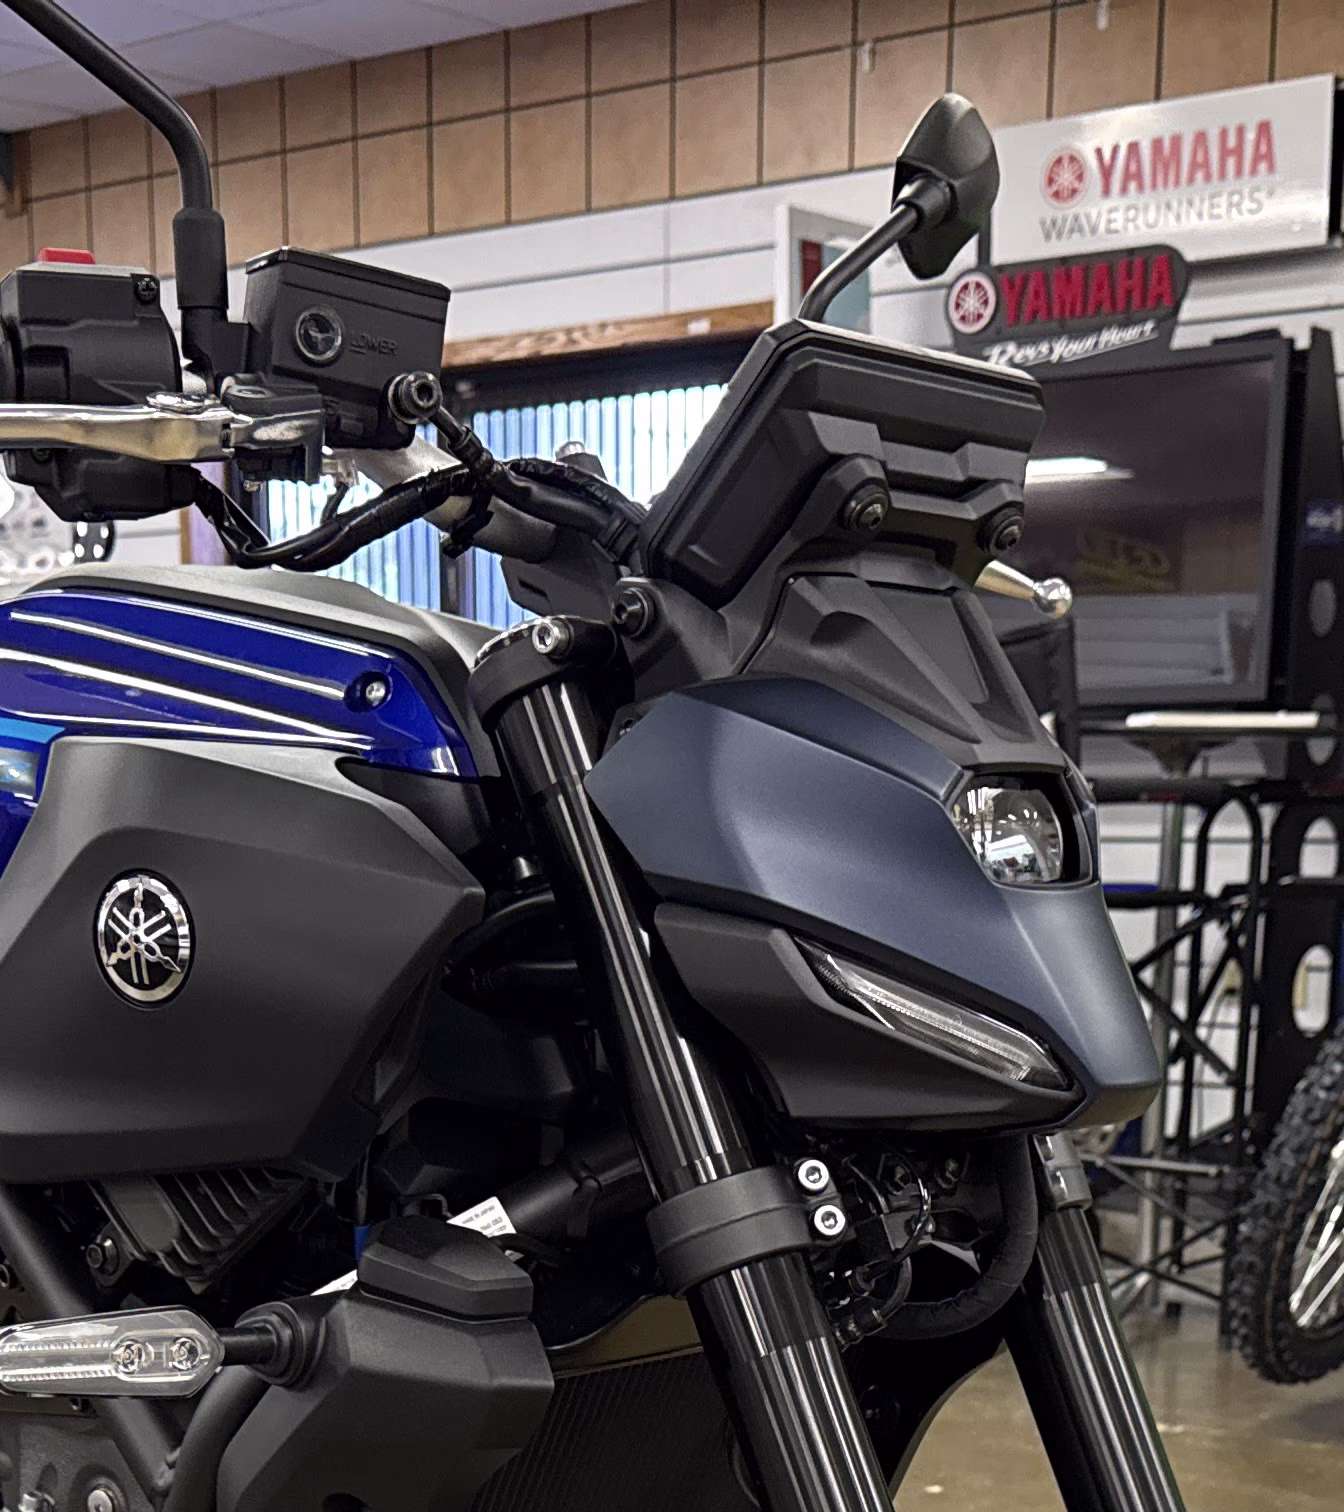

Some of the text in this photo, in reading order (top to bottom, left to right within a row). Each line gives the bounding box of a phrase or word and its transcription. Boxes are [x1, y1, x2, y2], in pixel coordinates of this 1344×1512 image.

[1094, 118, 1276, 198] YAMAHA
[999, 254, 1176, 327] YAMAHA
[349, 331, 398, 355] LOWER
